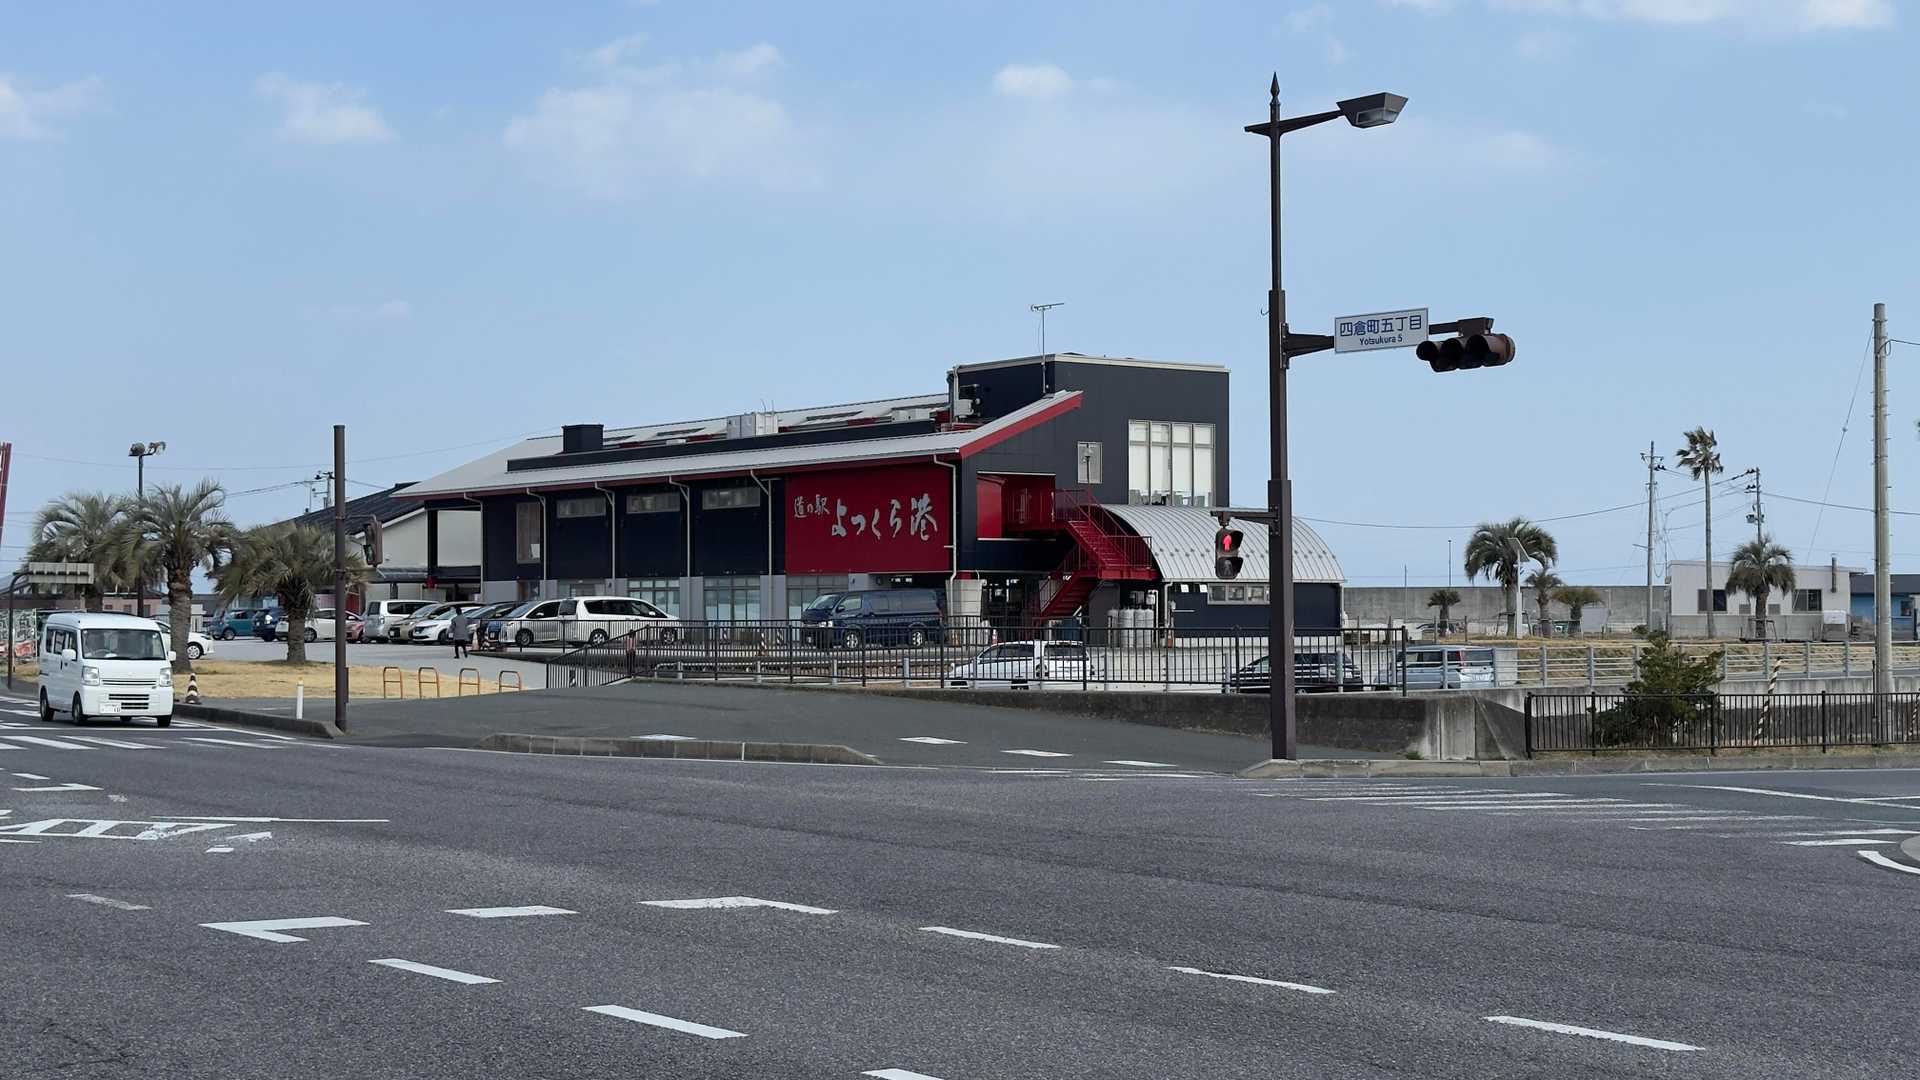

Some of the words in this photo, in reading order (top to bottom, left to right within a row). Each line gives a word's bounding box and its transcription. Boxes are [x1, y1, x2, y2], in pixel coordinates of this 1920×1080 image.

[1340, 315, 1422, 337] 四倉町五丁目
[1359, 335, 1397, 346] Yotsukura
[1397, 334, 1403, 342] 5
[794, 494, 831, 518] 道の駅
